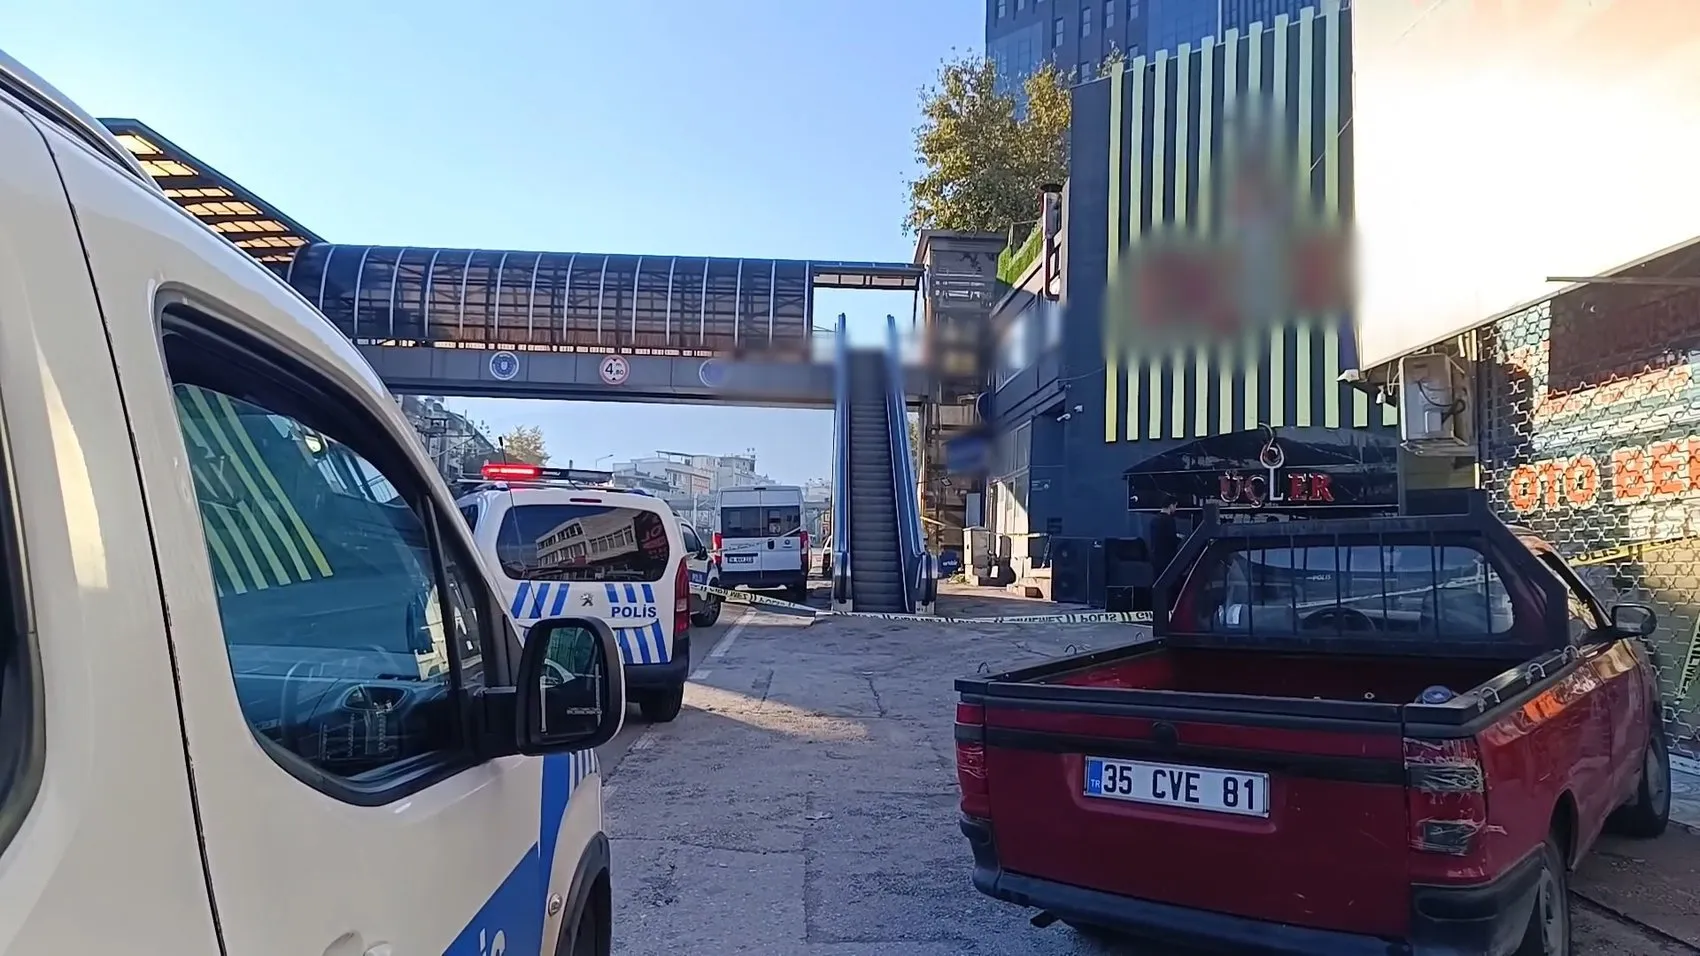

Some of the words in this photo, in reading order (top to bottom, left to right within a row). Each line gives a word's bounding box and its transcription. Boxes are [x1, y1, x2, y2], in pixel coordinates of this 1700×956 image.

[1509, 455, 1599, 514] OTO
[611, 604, 657, 618] POLİS
[1090, 778, 1101, 789] TR
[1103, 764, 1132, 795] 35
[1152, 769, 1200, 803] CVE
[1223, 776, 1254, 810] 81
